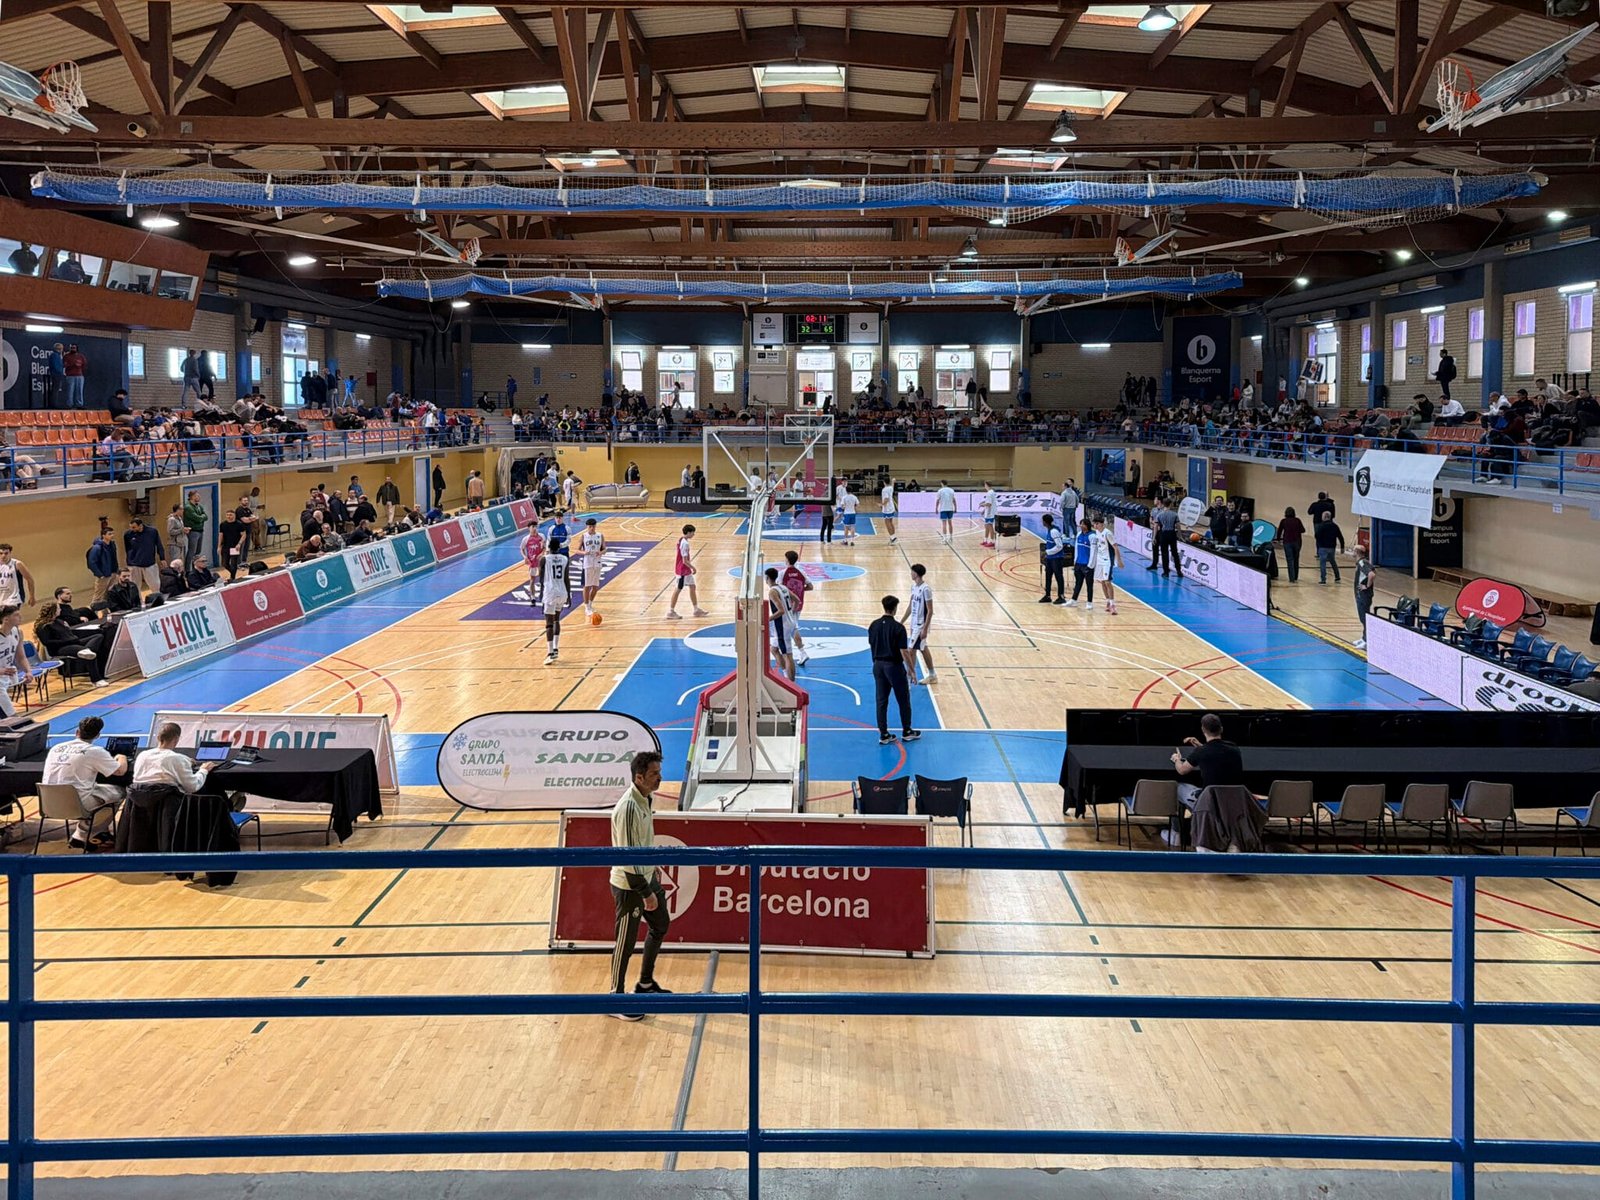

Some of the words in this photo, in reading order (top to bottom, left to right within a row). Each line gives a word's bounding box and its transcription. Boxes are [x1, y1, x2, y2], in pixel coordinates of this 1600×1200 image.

[801, 325, 810, 333] 32
[823, 325, 833, 333] 65
[1181, 367, 1222, 376] Blanquerna
[1189, 375, 1212, 384] Esport
[1423, 531, 1457, 539] Blanquerna
[552, 564, 563, 580] 13
[148, 619, 162, 636] WE
[160, 605, 215, 650] L'HOVE
[541, 729, 629, 742] GRUPO
[468, 739, 500, 751] GRUPO
[460, 750, 505, 765] SANDÁ
[534, 749, 636, 764] SANDÁ
[462, 767, 502, 778] ELECTROCLIMA
[543, 776, 626, 788] ELECTROCLIMA
[713, 886, 870, 918] Barcelona
